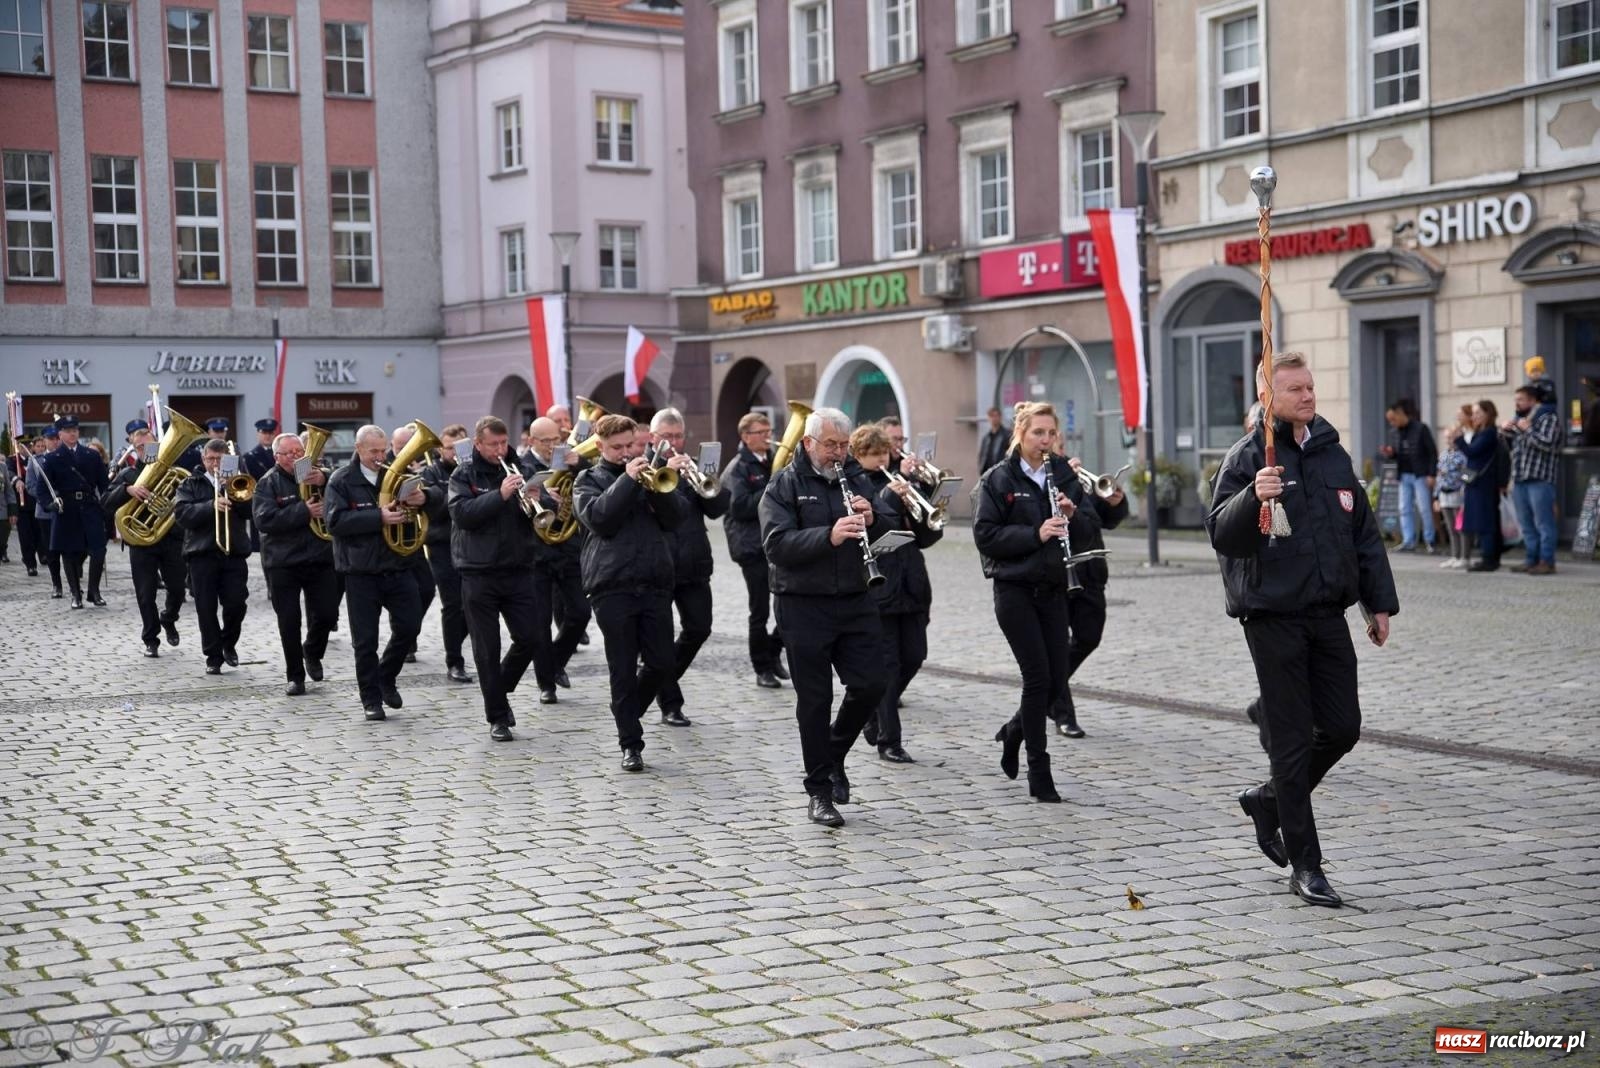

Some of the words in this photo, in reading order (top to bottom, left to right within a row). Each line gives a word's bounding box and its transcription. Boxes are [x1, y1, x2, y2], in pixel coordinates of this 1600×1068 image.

[1417, 191, 1533, 247] SHIRO
[1224, 223, 1373, 265] RESAURACJA
[802, 272, 908, 315] KANTOR
[149, 351, 266, 374] JUBILER
